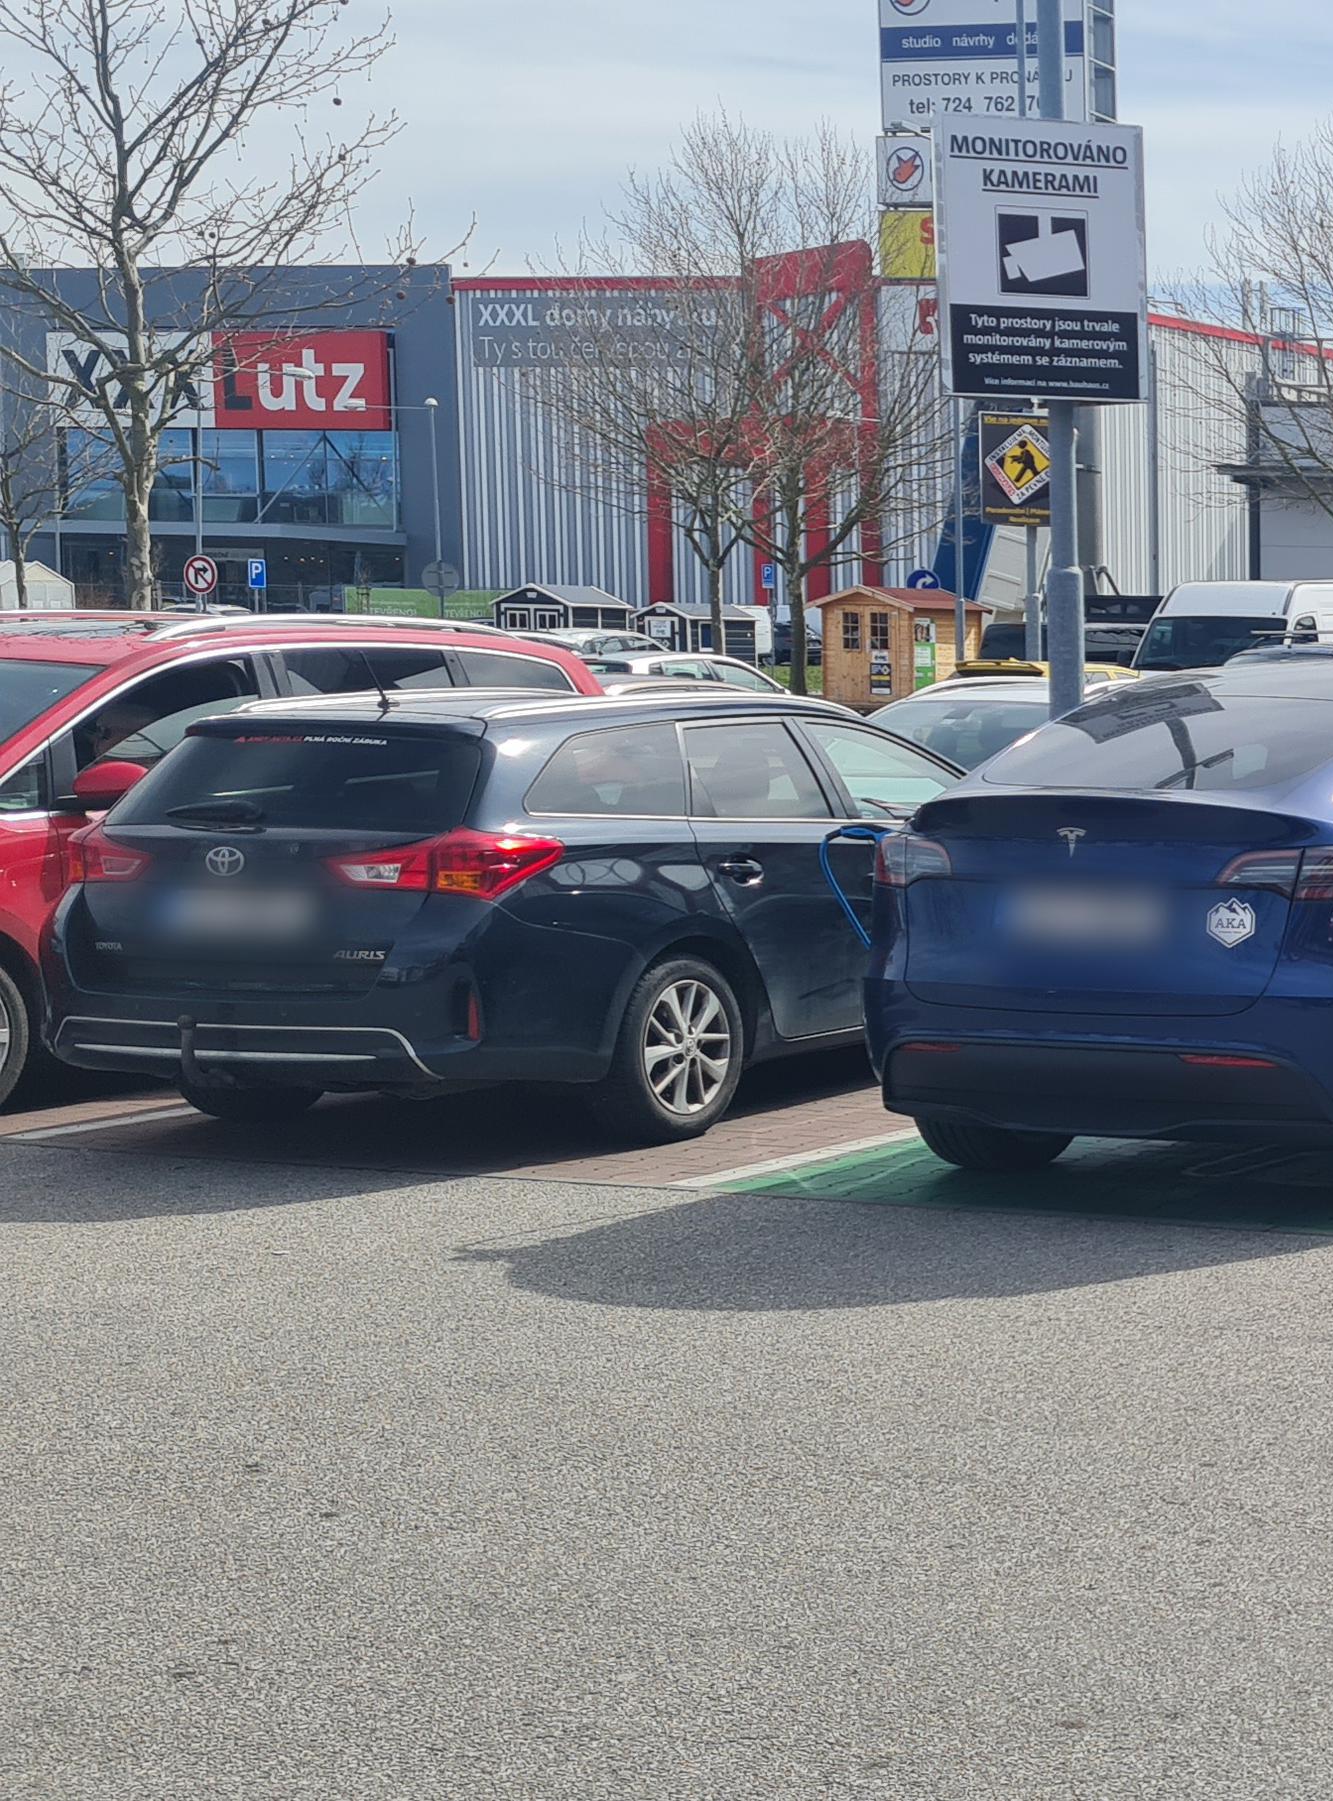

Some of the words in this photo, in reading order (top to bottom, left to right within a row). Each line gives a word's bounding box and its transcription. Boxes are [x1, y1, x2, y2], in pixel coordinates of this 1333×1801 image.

[901, 34, 941, 49] studio
[952, 33, 995, 51] návrhy
[891, 71, 971, 87] PROSTORY
[975, 71, 987, 85] K
[908, 97, 936, 115] tel:
[942, 97, 973, 113] 724
[983, 95, 1016, 112] 762
[950, 134, 1128, 166] MONITOROVÁNO
[982, 167, 1099, 194] KAMERAMI
[478, 303, 540, 328] XXXL
[545, 302, 612, 333] domy
[969, 313, 997, 328] Tyto
[1000, 315, 1051, 332] prostory
[1055, 317, 1081, 332] jsou
[1084, 318, 1120, 333] trvale
[479, 336, 506, 364] Ty
[511, 342, 522, 360] s
[963, 333, 1051, 349] monitorovány
[1054, 336, 1128, 352] kamerovým
[968, 350, 1033, 366] systémem
[1035, 355, 1049, 366] se
[1052, 354, 1124, 369] záznamem.
[251, 563, 263, 579] P
[764, 566, 772, 579] P
[1214, 918, 1247, 929] AKA
[95, 941, 122, 951] TOYOTA
[333, 950, 386, 960] AURIS
